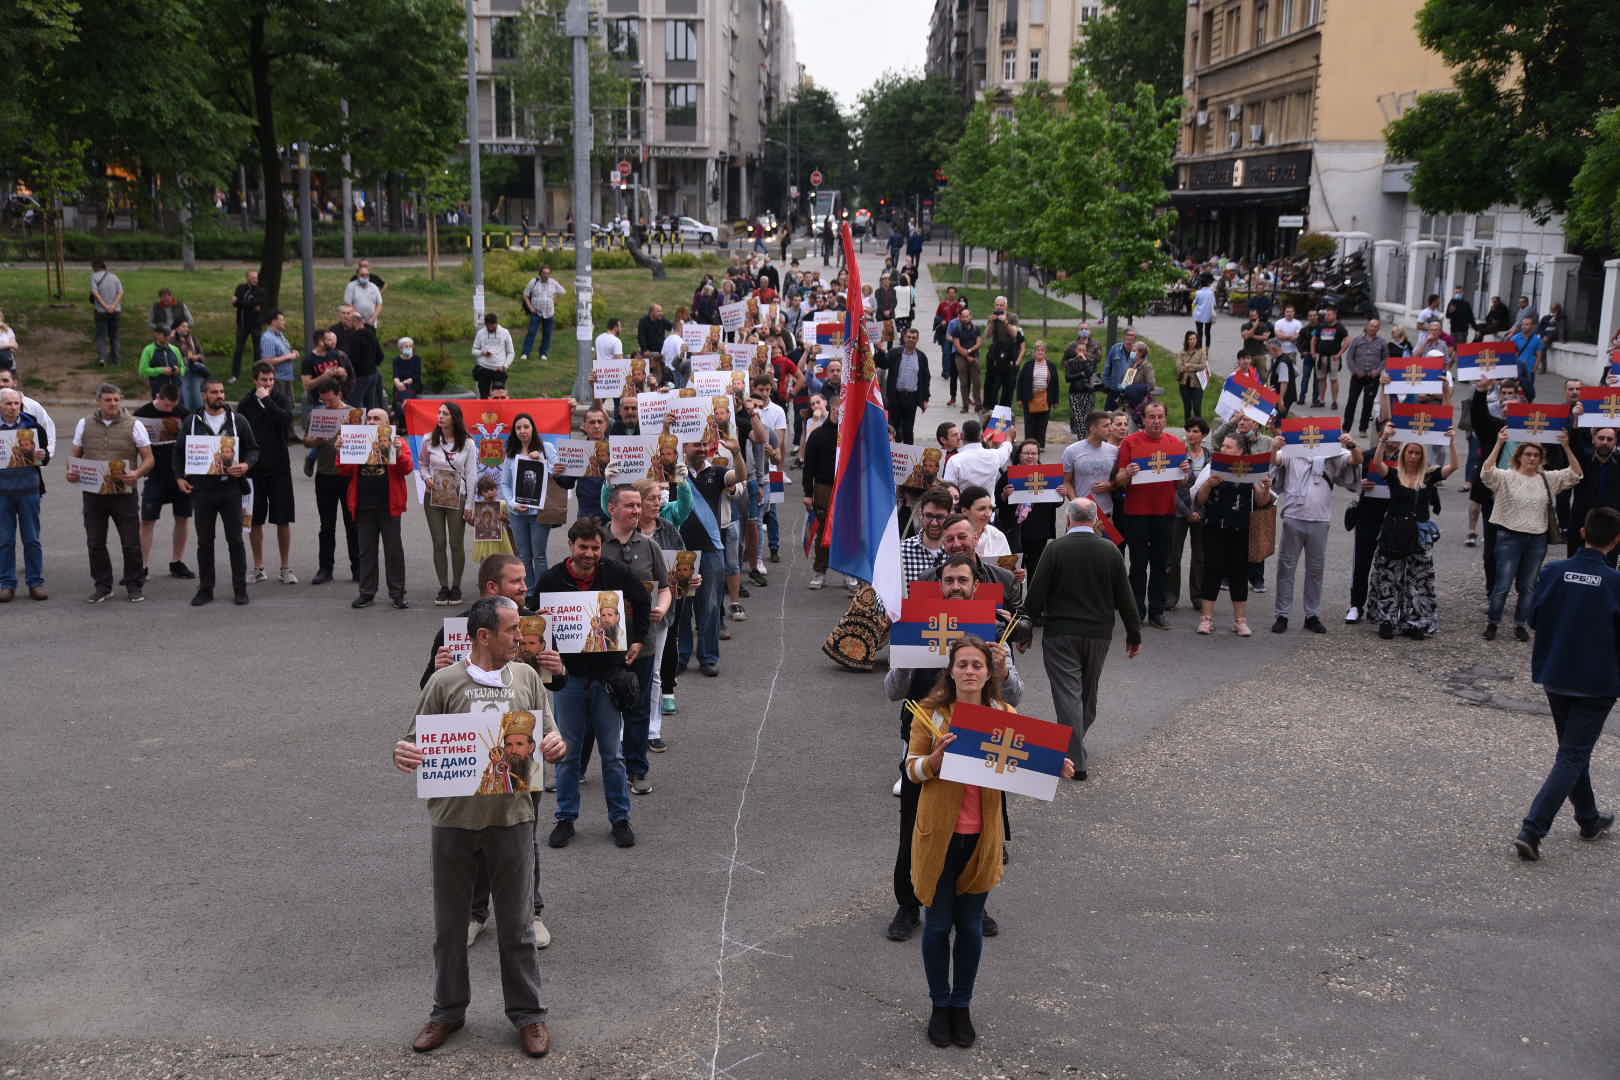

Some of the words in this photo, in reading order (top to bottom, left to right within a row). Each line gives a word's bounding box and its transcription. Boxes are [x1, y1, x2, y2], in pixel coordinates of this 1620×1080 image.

[557, 605, 582, 614] ДАМО
[557, 624, 582, 632] ДАМО
[448, 633, 462, 641] НЕ
[421, 733, 437, 743] НЕ
[441, 731, 476, 744] ДАМО
[422, 744, 476, 755] СВЕТИЊЕ!
[422, 758, 438, 768] НЕ
[441, 757, 477, 769] ДАМО
[422, 769, 476, 780] ВЛАДИКУ!
